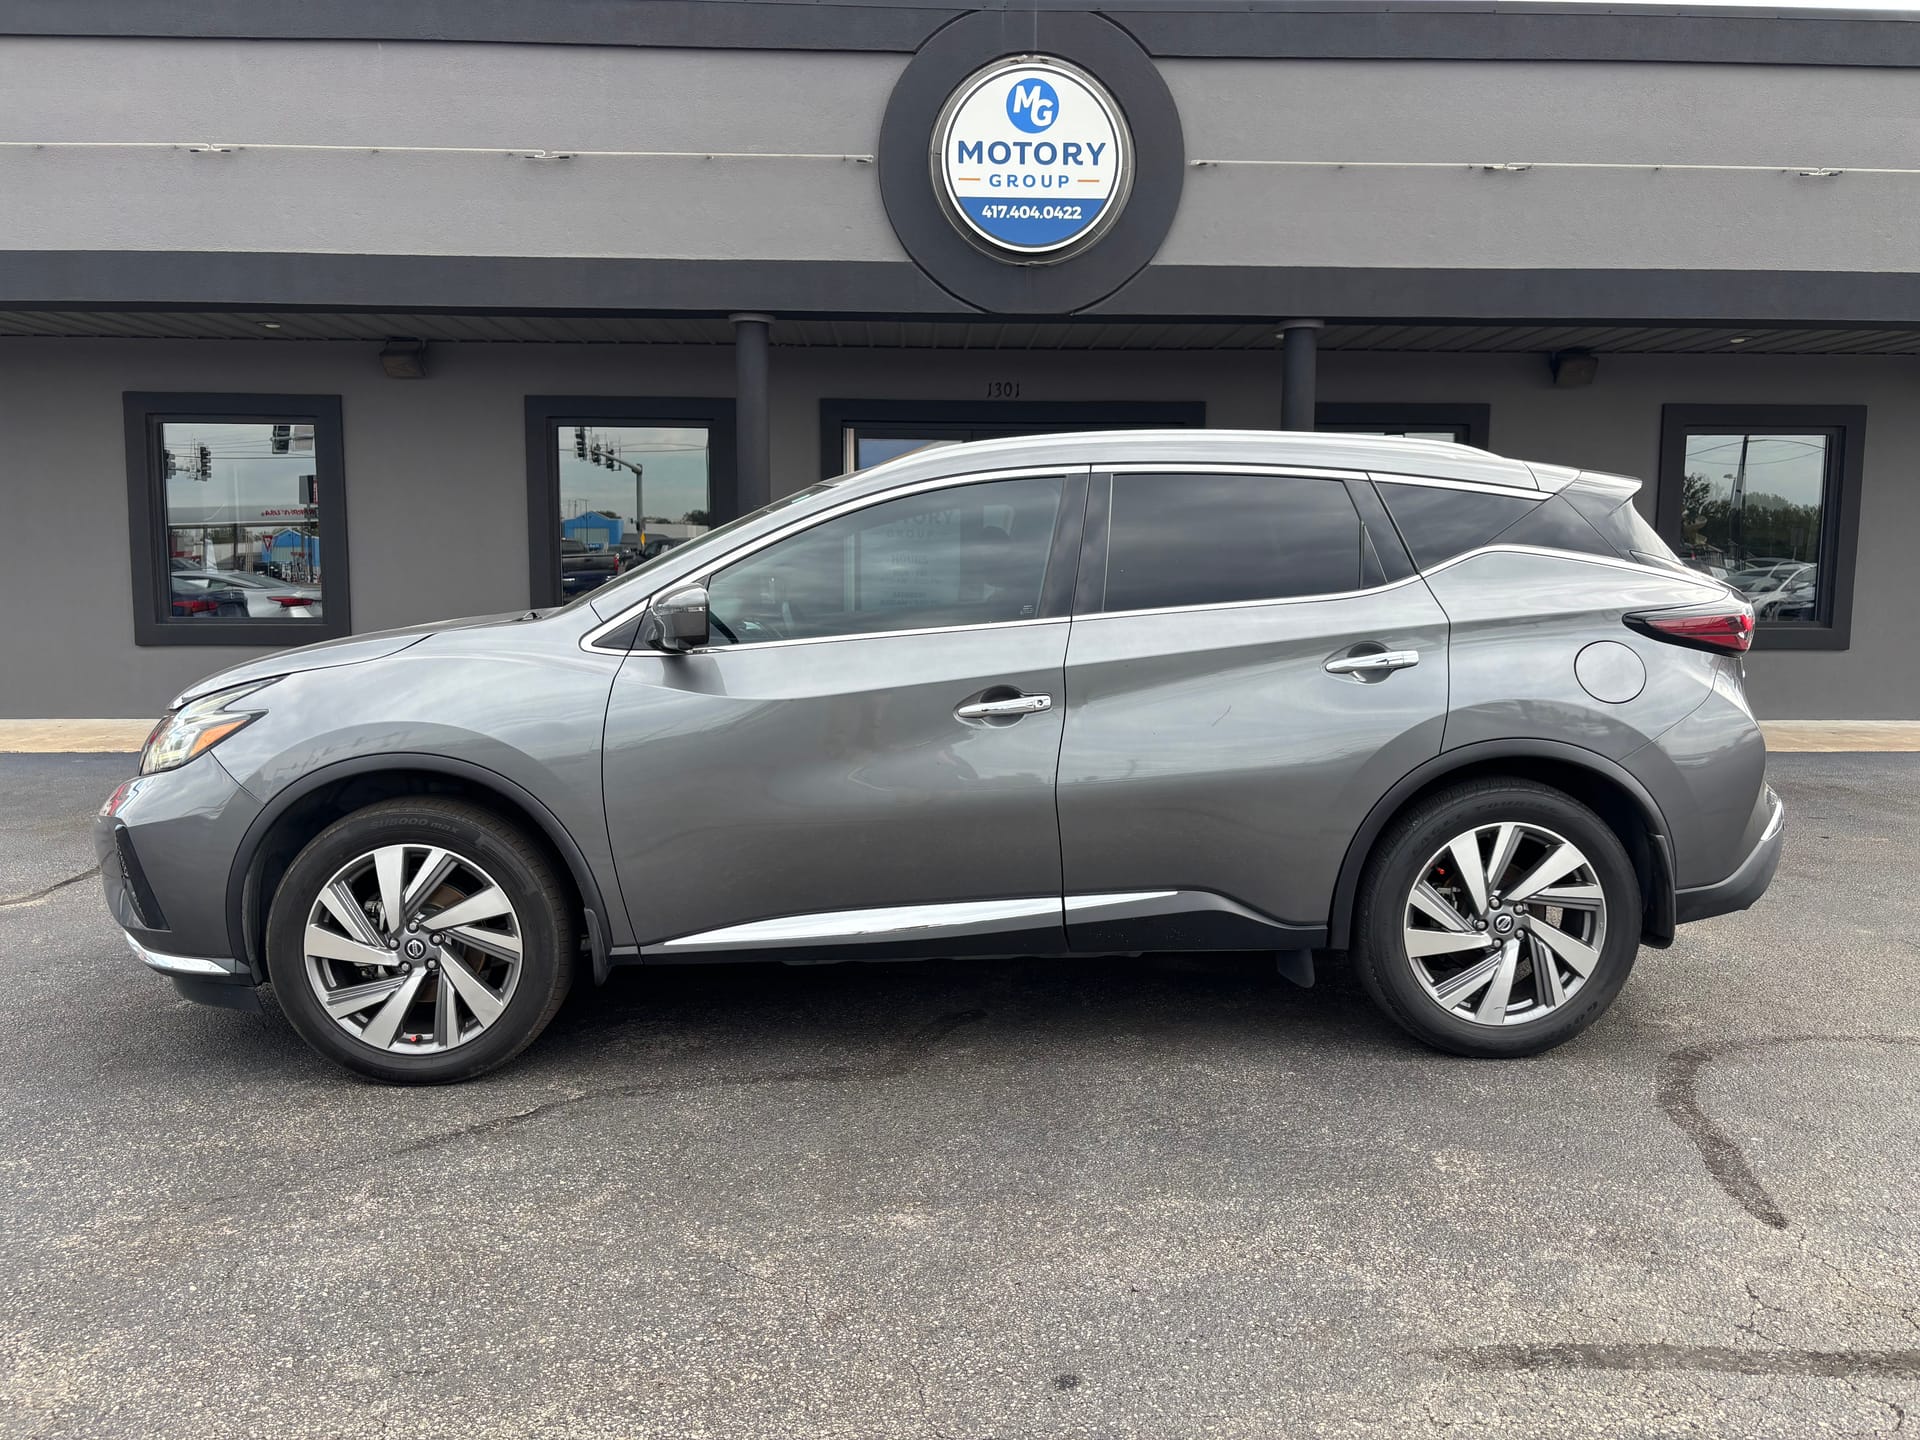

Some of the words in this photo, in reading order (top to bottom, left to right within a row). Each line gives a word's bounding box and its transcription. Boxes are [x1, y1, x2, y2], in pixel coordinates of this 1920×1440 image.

[1013, 85, 1054, 127] MG
[957, 140, 1107, 166] MOTORY
[989, 174, 1070, 188] GROUP
[981, 205, 1082, 220] 417.404.0422
[986, 382, 1020, 399] 1301
